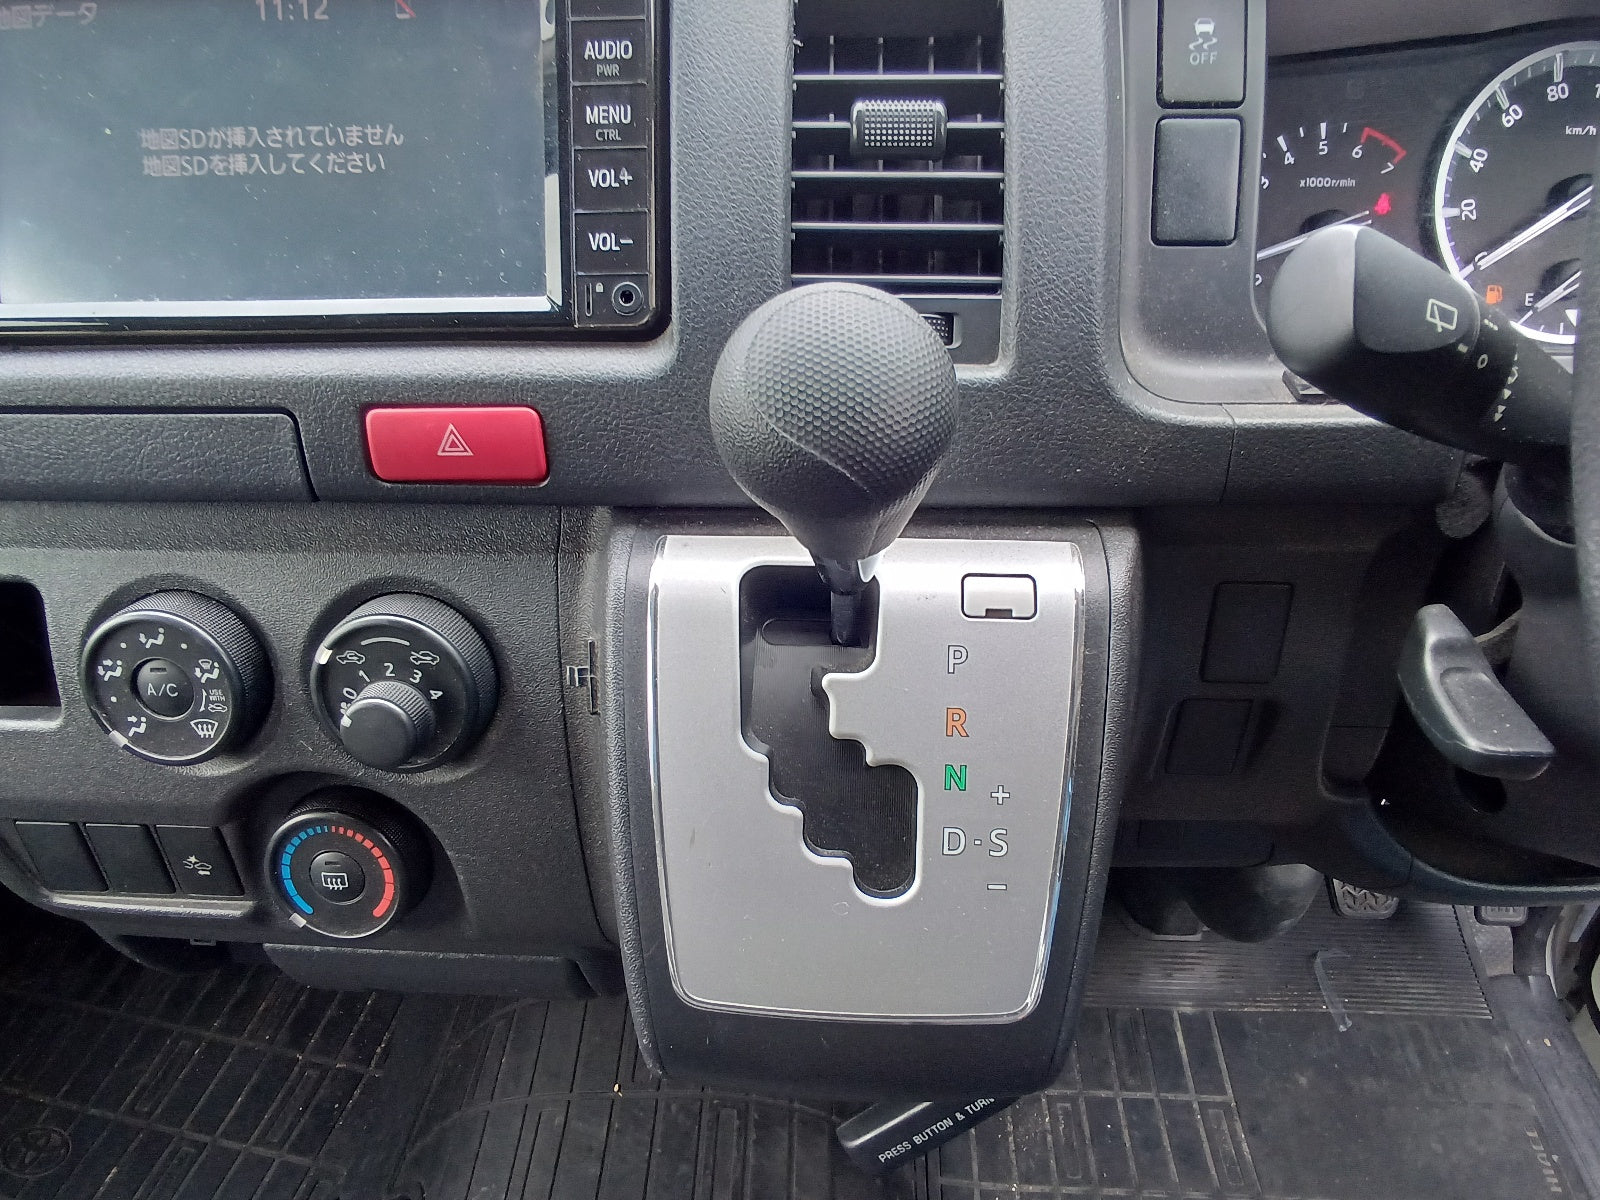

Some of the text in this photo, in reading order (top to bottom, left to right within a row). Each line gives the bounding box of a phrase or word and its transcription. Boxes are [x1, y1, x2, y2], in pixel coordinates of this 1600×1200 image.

[255, 0, 329, 21] 11:12
[584, 40, 633, 60] AUDIO
[1189, 52, 1218, 66] OFF
[596, 63, 620, 77] PWR
[1547, 82, 1570, 102] 80
[585, 104, 632, 125] MENU
[1501, 104, 1523, 128] 60
[595, 128, 622, 142] CTRL
[1565, 125, 1597, 136] km/h
[1284, 151, 1295, 165] 4
[1318, 140, 1328, 156] 5
[1351, 144, 1363, 159] 6
[142, 152, 386, 177] 地図SDを挿入してください
[1380, 161, 1395, 175] 7
[1469, 148, 1489, 173] 40
[588, 168, 633, 189] VOL+
[1461, 198, 1477, 222] 20
[1524, 292, 1535, 307] E
[947, 644, 969, 675] P
[147, 682, 179, 697] A/C
[358, 669, 371, 683] 1
[383, 662, 396, 677] 2
[409, 669, 423, 684] 3
[429, 689, 444, 700] 4
[946, 708, 969, 737] R
[944, 765, 967, 791] N
[878, 1141, 912, 1163] PRESS
[913, 1117, 953, 1145] BUTTON
[955, 1112, 965, 1121] &
